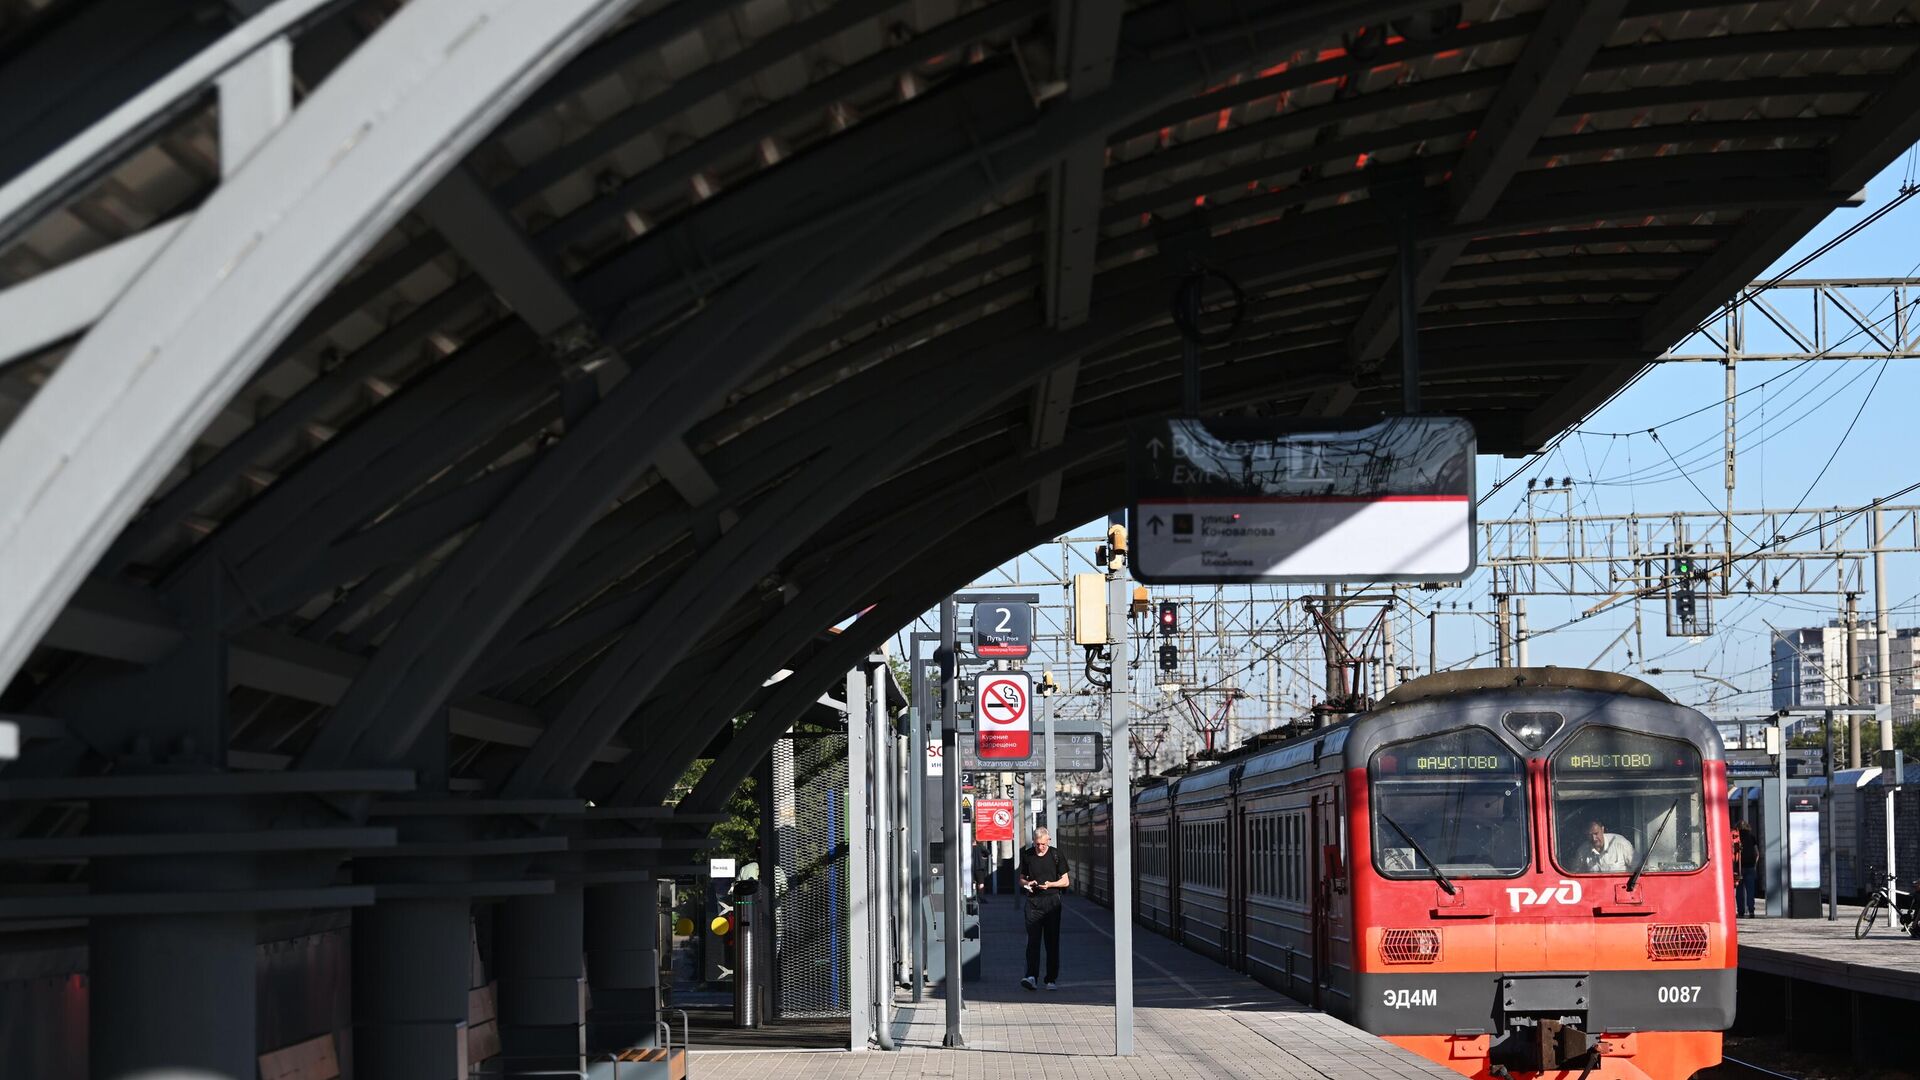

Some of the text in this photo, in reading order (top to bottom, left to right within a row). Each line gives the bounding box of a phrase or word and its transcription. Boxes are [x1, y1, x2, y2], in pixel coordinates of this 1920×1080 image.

[1201, 527, 1275, 537] Коновалова
[995, 607, 1012, 633] 2
[986, 635, 1002, 643] Путь
[1071, 760, 1081, 768] 16
[1417, 756, 1498, 769] ФАУСТОВО
[1570, 754, 1651, 768] ФАУСТОВО
[962, 774, 969, 783] 2
[1383, 989, 1437, 1009] ЭД4М
[1658, 985, 1702, 1004] 0087
